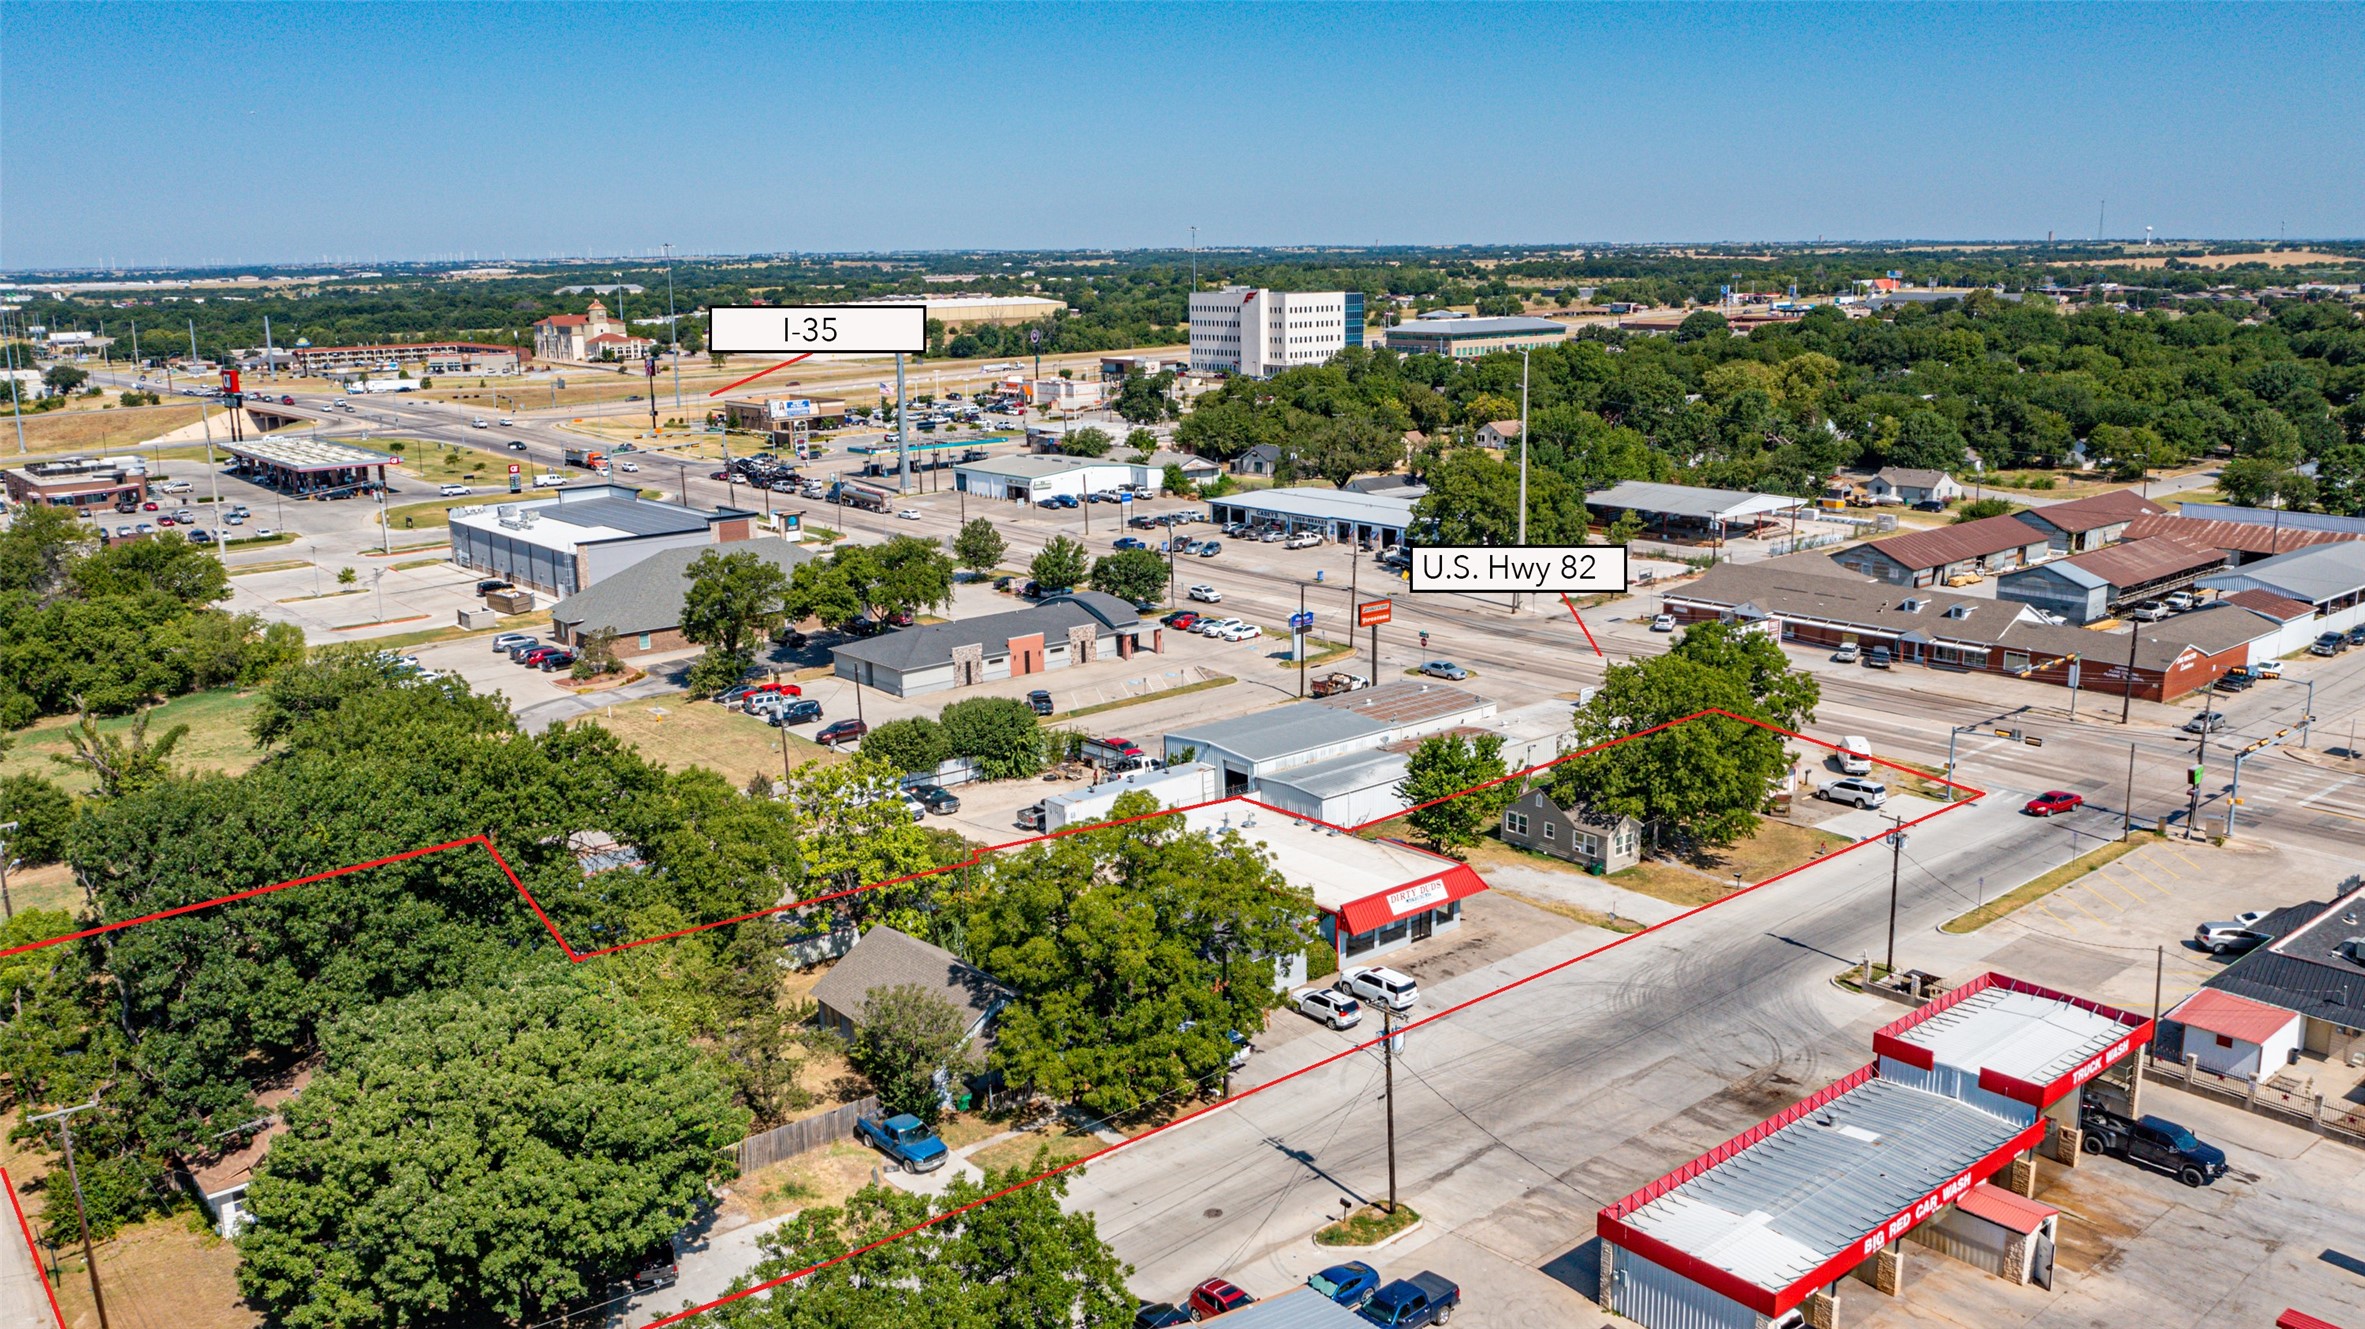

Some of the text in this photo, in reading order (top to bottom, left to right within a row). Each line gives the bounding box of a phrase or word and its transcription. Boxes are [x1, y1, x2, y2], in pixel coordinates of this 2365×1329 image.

[1390, 888, 1416, 903] DIRTY
[1420, 881, 1441, 894] DUDS
[2072, 1039, 2130, 1085] TRUCK WASH
[1864, 1172, 1971, 1255] BIG RED CAR WASH
